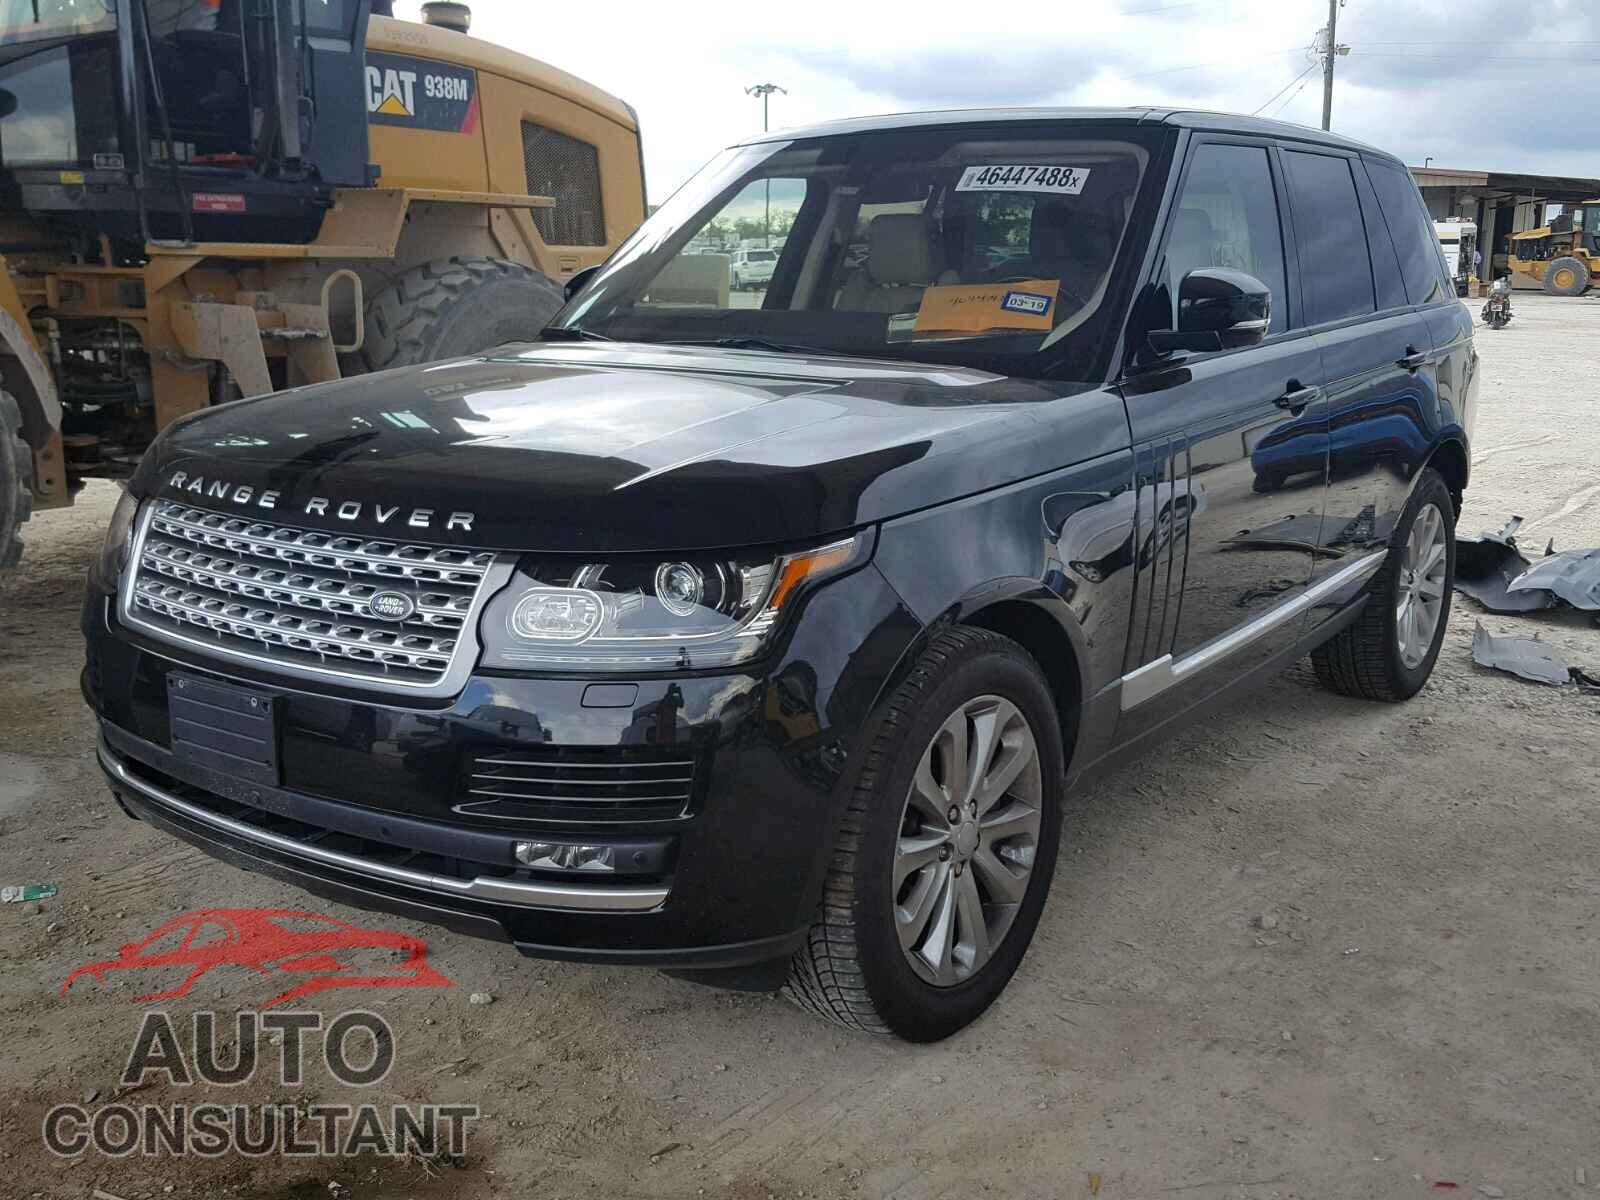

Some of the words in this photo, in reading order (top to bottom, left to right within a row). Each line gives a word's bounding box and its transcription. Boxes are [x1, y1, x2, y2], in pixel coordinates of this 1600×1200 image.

[364, 66, 417, 116] CAT
[424, 75, 468, 101] 938M
[169, 470, 281, 508] RANGE
[305, 496, 476, 532] ROVER
[378, 596, 400, 606] LAND
[378, 605, 405, 615] ROVER
